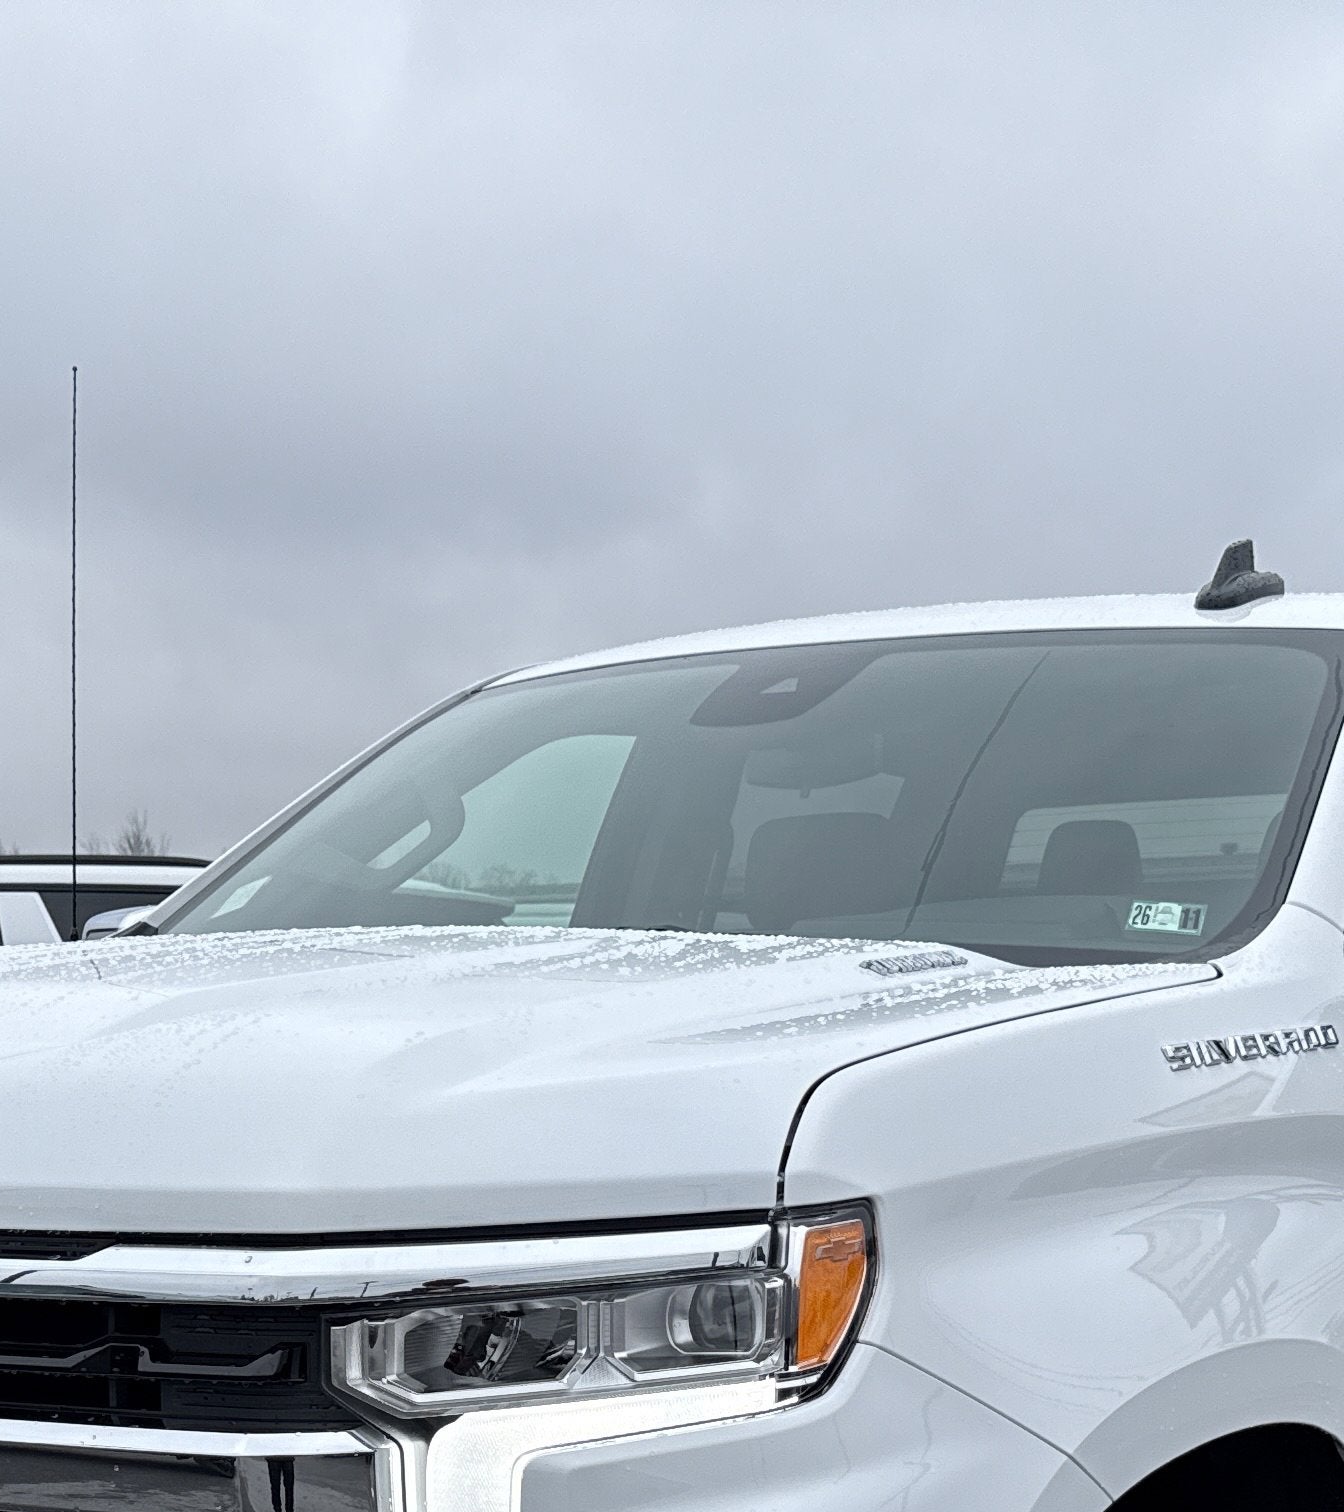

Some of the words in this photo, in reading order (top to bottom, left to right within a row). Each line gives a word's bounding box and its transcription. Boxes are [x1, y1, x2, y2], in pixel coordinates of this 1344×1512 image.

[1131, 904, 1153, 926] 26
[1181, 908, 1202, 929] 11
[1160, 1025, 1339, 1072] SILVERADO
